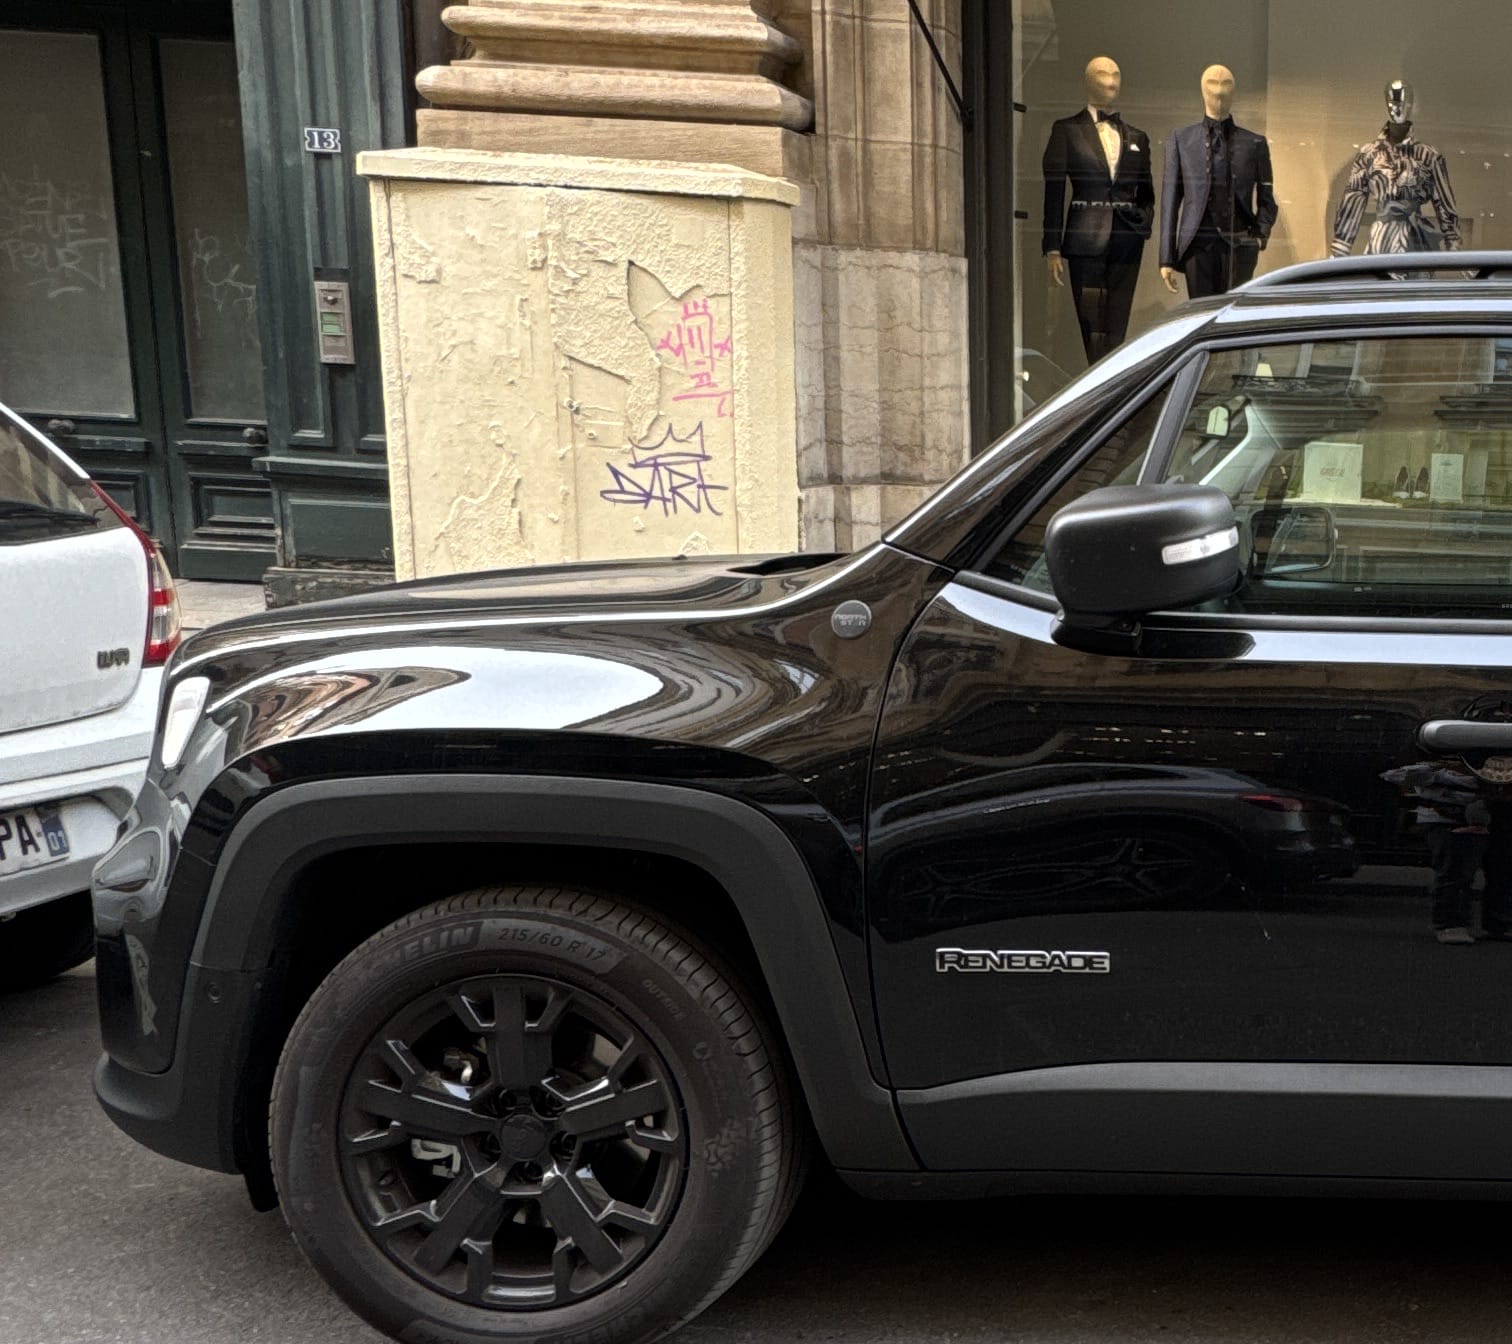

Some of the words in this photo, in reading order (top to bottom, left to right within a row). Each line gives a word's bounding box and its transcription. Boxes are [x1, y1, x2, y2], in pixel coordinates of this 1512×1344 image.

[311, 130, 336, 150] 13
[47, 829, 68, 852] 01
[498, 927, 564, 947] 215/60
[936, 947, 1110, 974] RENEGADE
